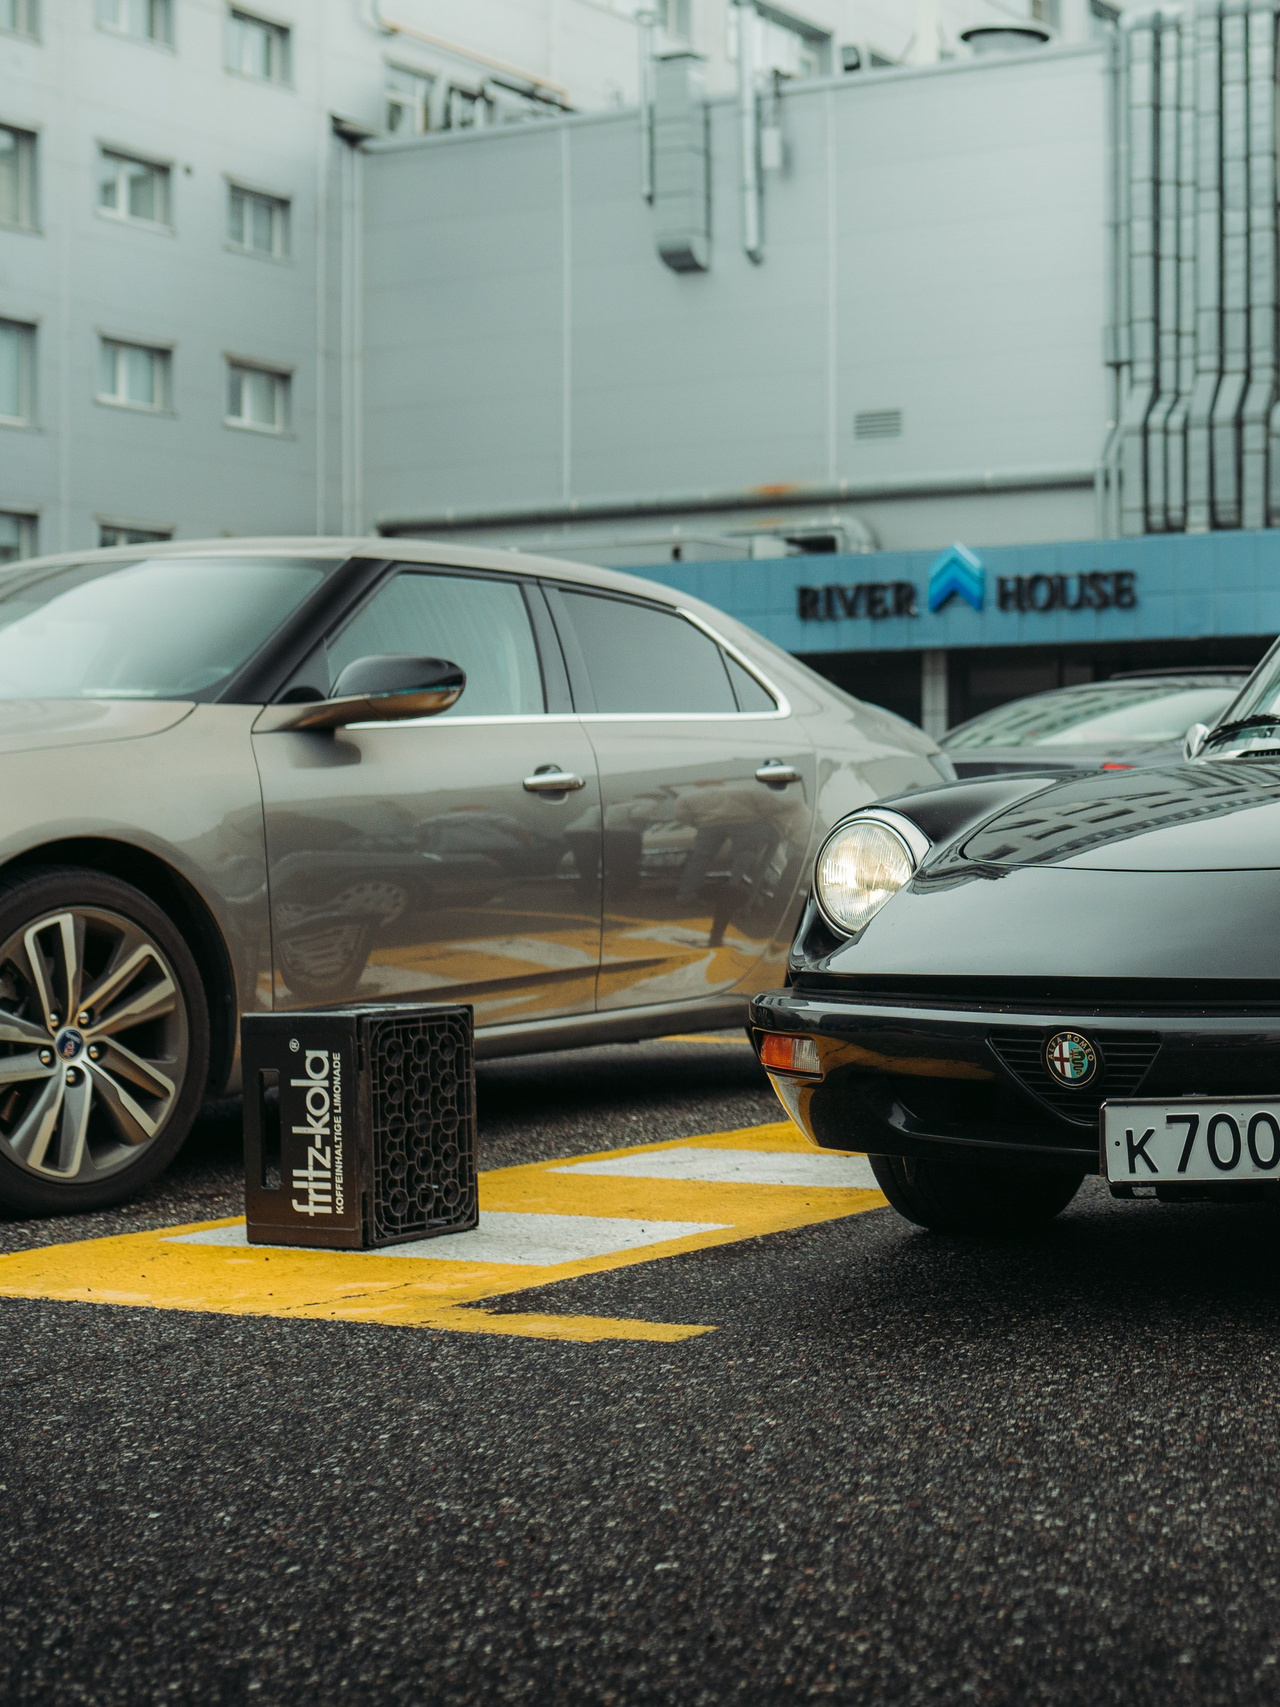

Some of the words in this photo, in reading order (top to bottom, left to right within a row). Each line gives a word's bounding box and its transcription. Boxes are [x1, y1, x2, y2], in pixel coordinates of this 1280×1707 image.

[796, 581, 918, 621] RIVER
[995, 570, 1138, 613] HOUSE
[1048, 1036, 1063, 1060] ALFA
[1066, 1034, 1095, 1062] ROMEO
[332, 1052, 342, 1114] LIMONADE
[291, 1049, 333, 1217] fritz-kola
[333, 1115, 345, 1215] KOFFEINHALTIGE
